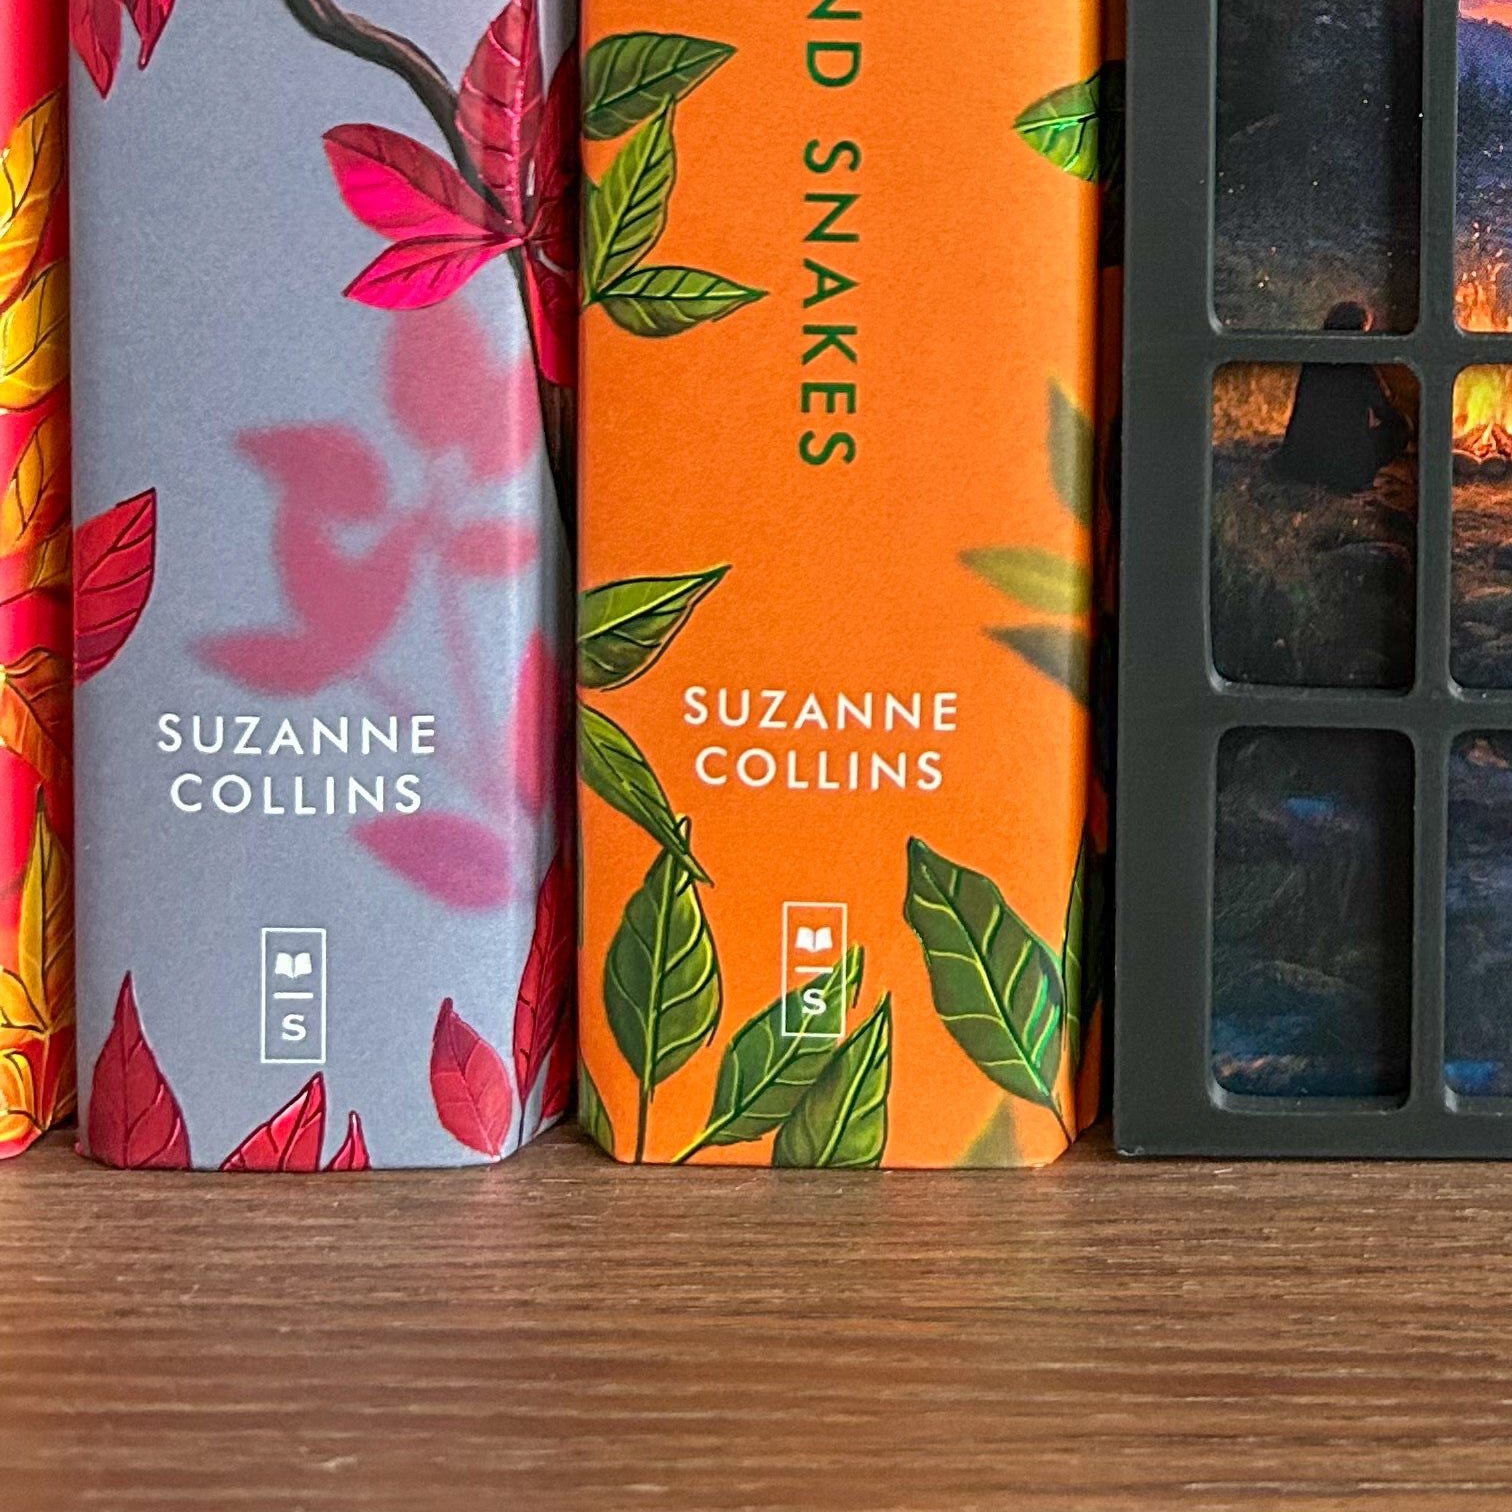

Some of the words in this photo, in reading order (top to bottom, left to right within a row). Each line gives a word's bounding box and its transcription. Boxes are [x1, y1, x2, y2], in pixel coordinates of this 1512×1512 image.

[798, 138, 860, 467] SNAKES
[684, 685, 957, 731] SUZANNE
[157, 712, 436, 756] SUZANNE
[695, 745, 943, 791] COLLINS
[169, 772, 423, 816] COLLINS
[801, 987, 828, 1017] S
[280, 1012, 308, 1043] S
